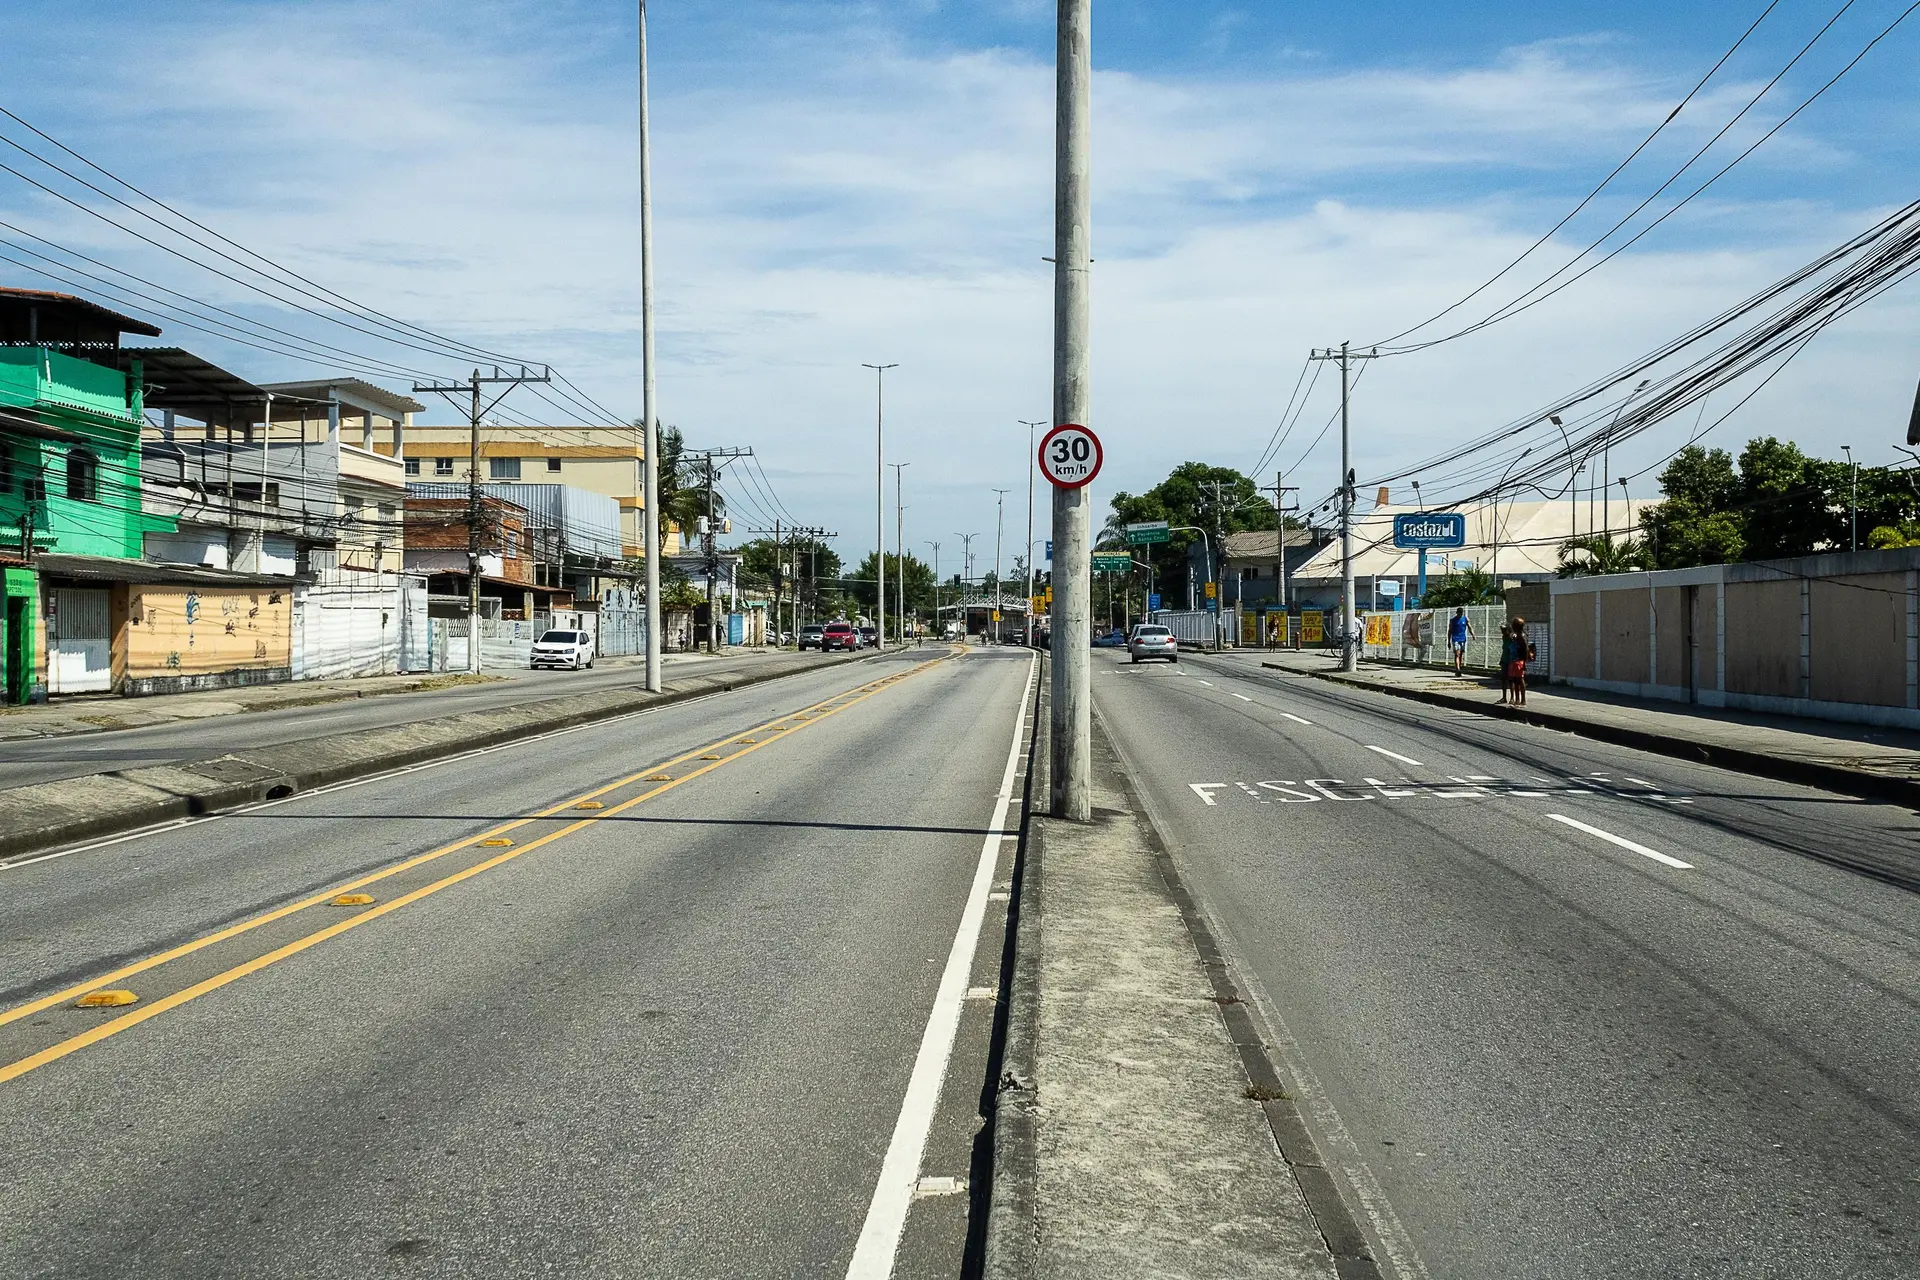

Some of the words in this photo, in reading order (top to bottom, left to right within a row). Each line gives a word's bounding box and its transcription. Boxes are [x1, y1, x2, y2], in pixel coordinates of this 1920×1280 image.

[1052, 437, 1090, 463] 30
[1055, 464, 1087, 475] km/h
[1403, 520, 1457, 537] costazul
